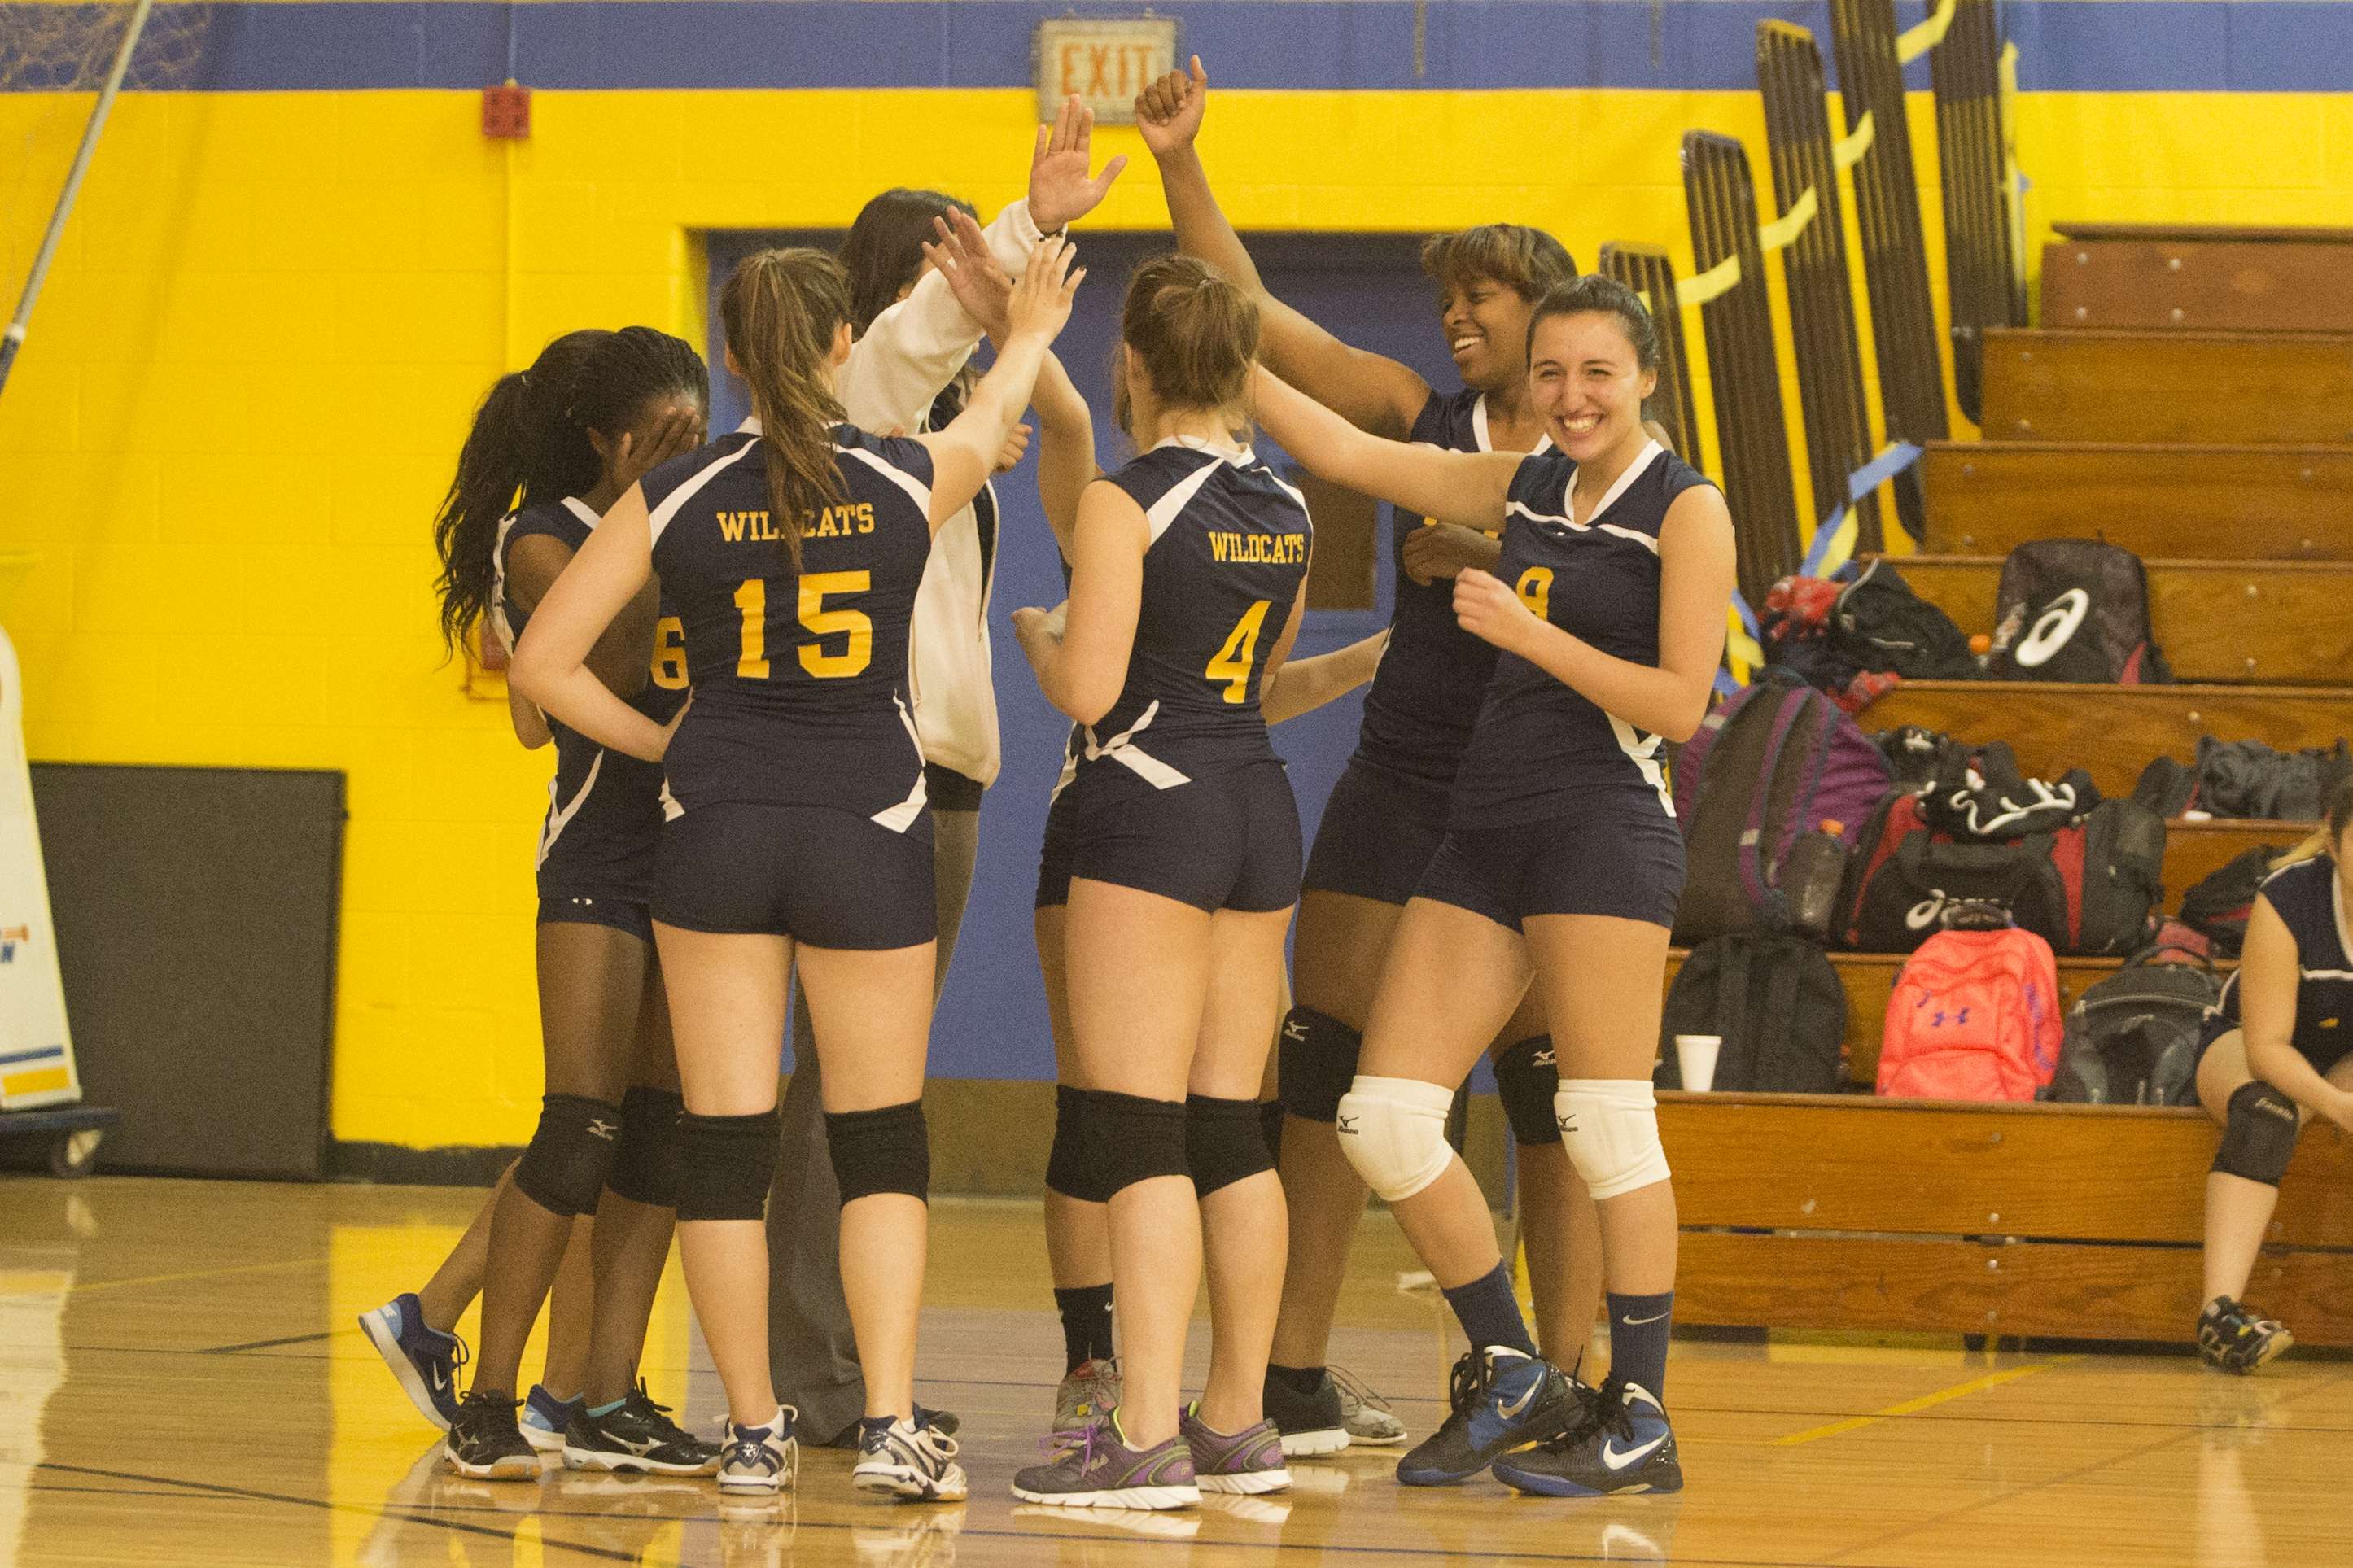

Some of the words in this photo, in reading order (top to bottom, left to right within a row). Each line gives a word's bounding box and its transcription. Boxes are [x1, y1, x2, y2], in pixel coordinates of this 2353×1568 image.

[1061, 42, 1155, 97] EXIT
[716, 502, 875, 543] WILCATS
[1209, 531, 1305, 564] WILDCATS
[651, 615, 691, 691] 6
[733, 570, 873, 679] 15
[1205, 599, 1272, 705] 4
